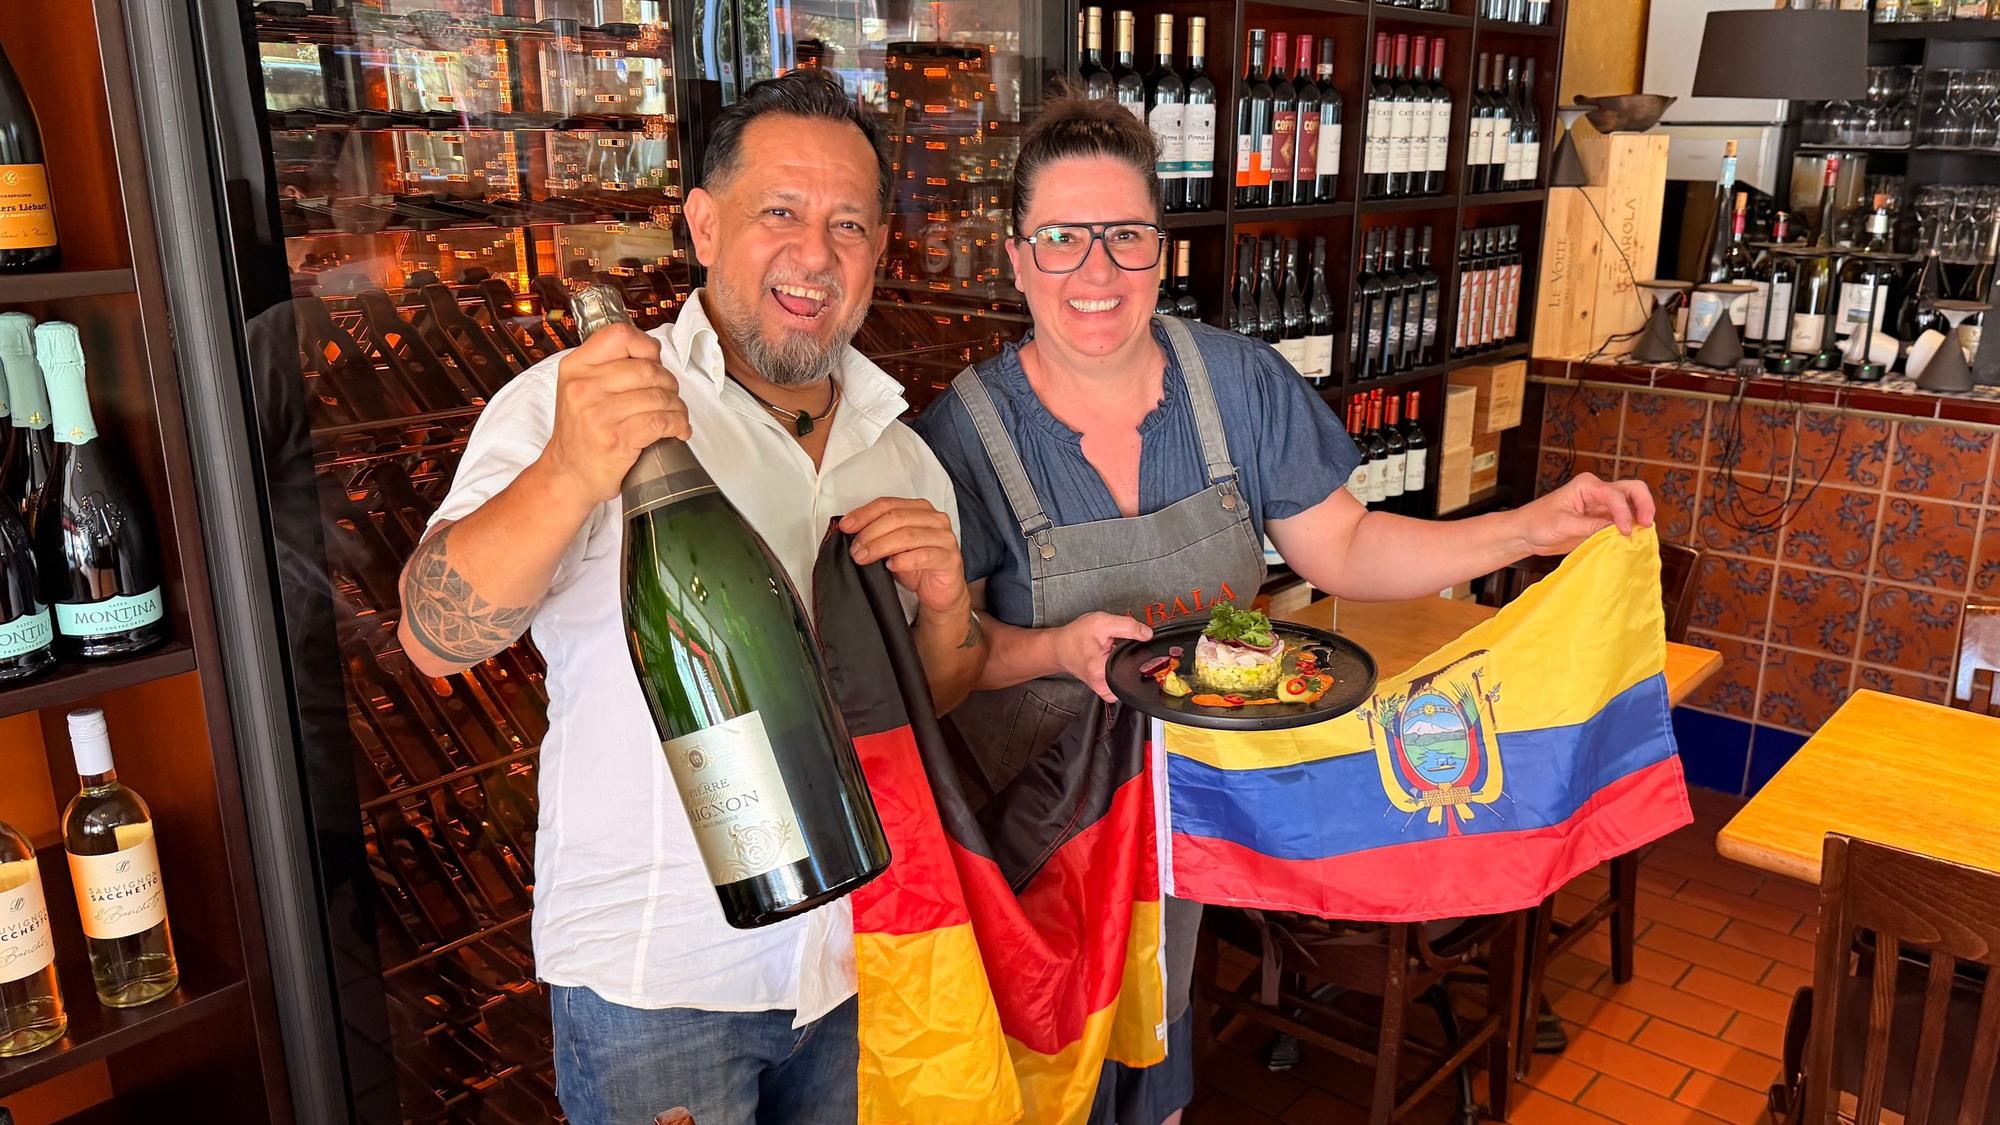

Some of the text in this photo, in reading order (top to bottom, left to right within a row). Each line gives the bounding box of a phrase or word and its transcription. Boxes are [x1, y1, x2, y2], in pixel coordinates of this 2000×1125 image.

[74, 599, 157, 625] MONTINA
[1126, 581, 1237, 627] BALA
[0, 618, 50, 646] ONTIN
[88, 869, 157, 895] SAUVIGNON
[90, 877, 158, 902] SACCHETTO
[0, 907, 47, 935] UVIGNO
[0, 913, 47, 942] CCHETTO
